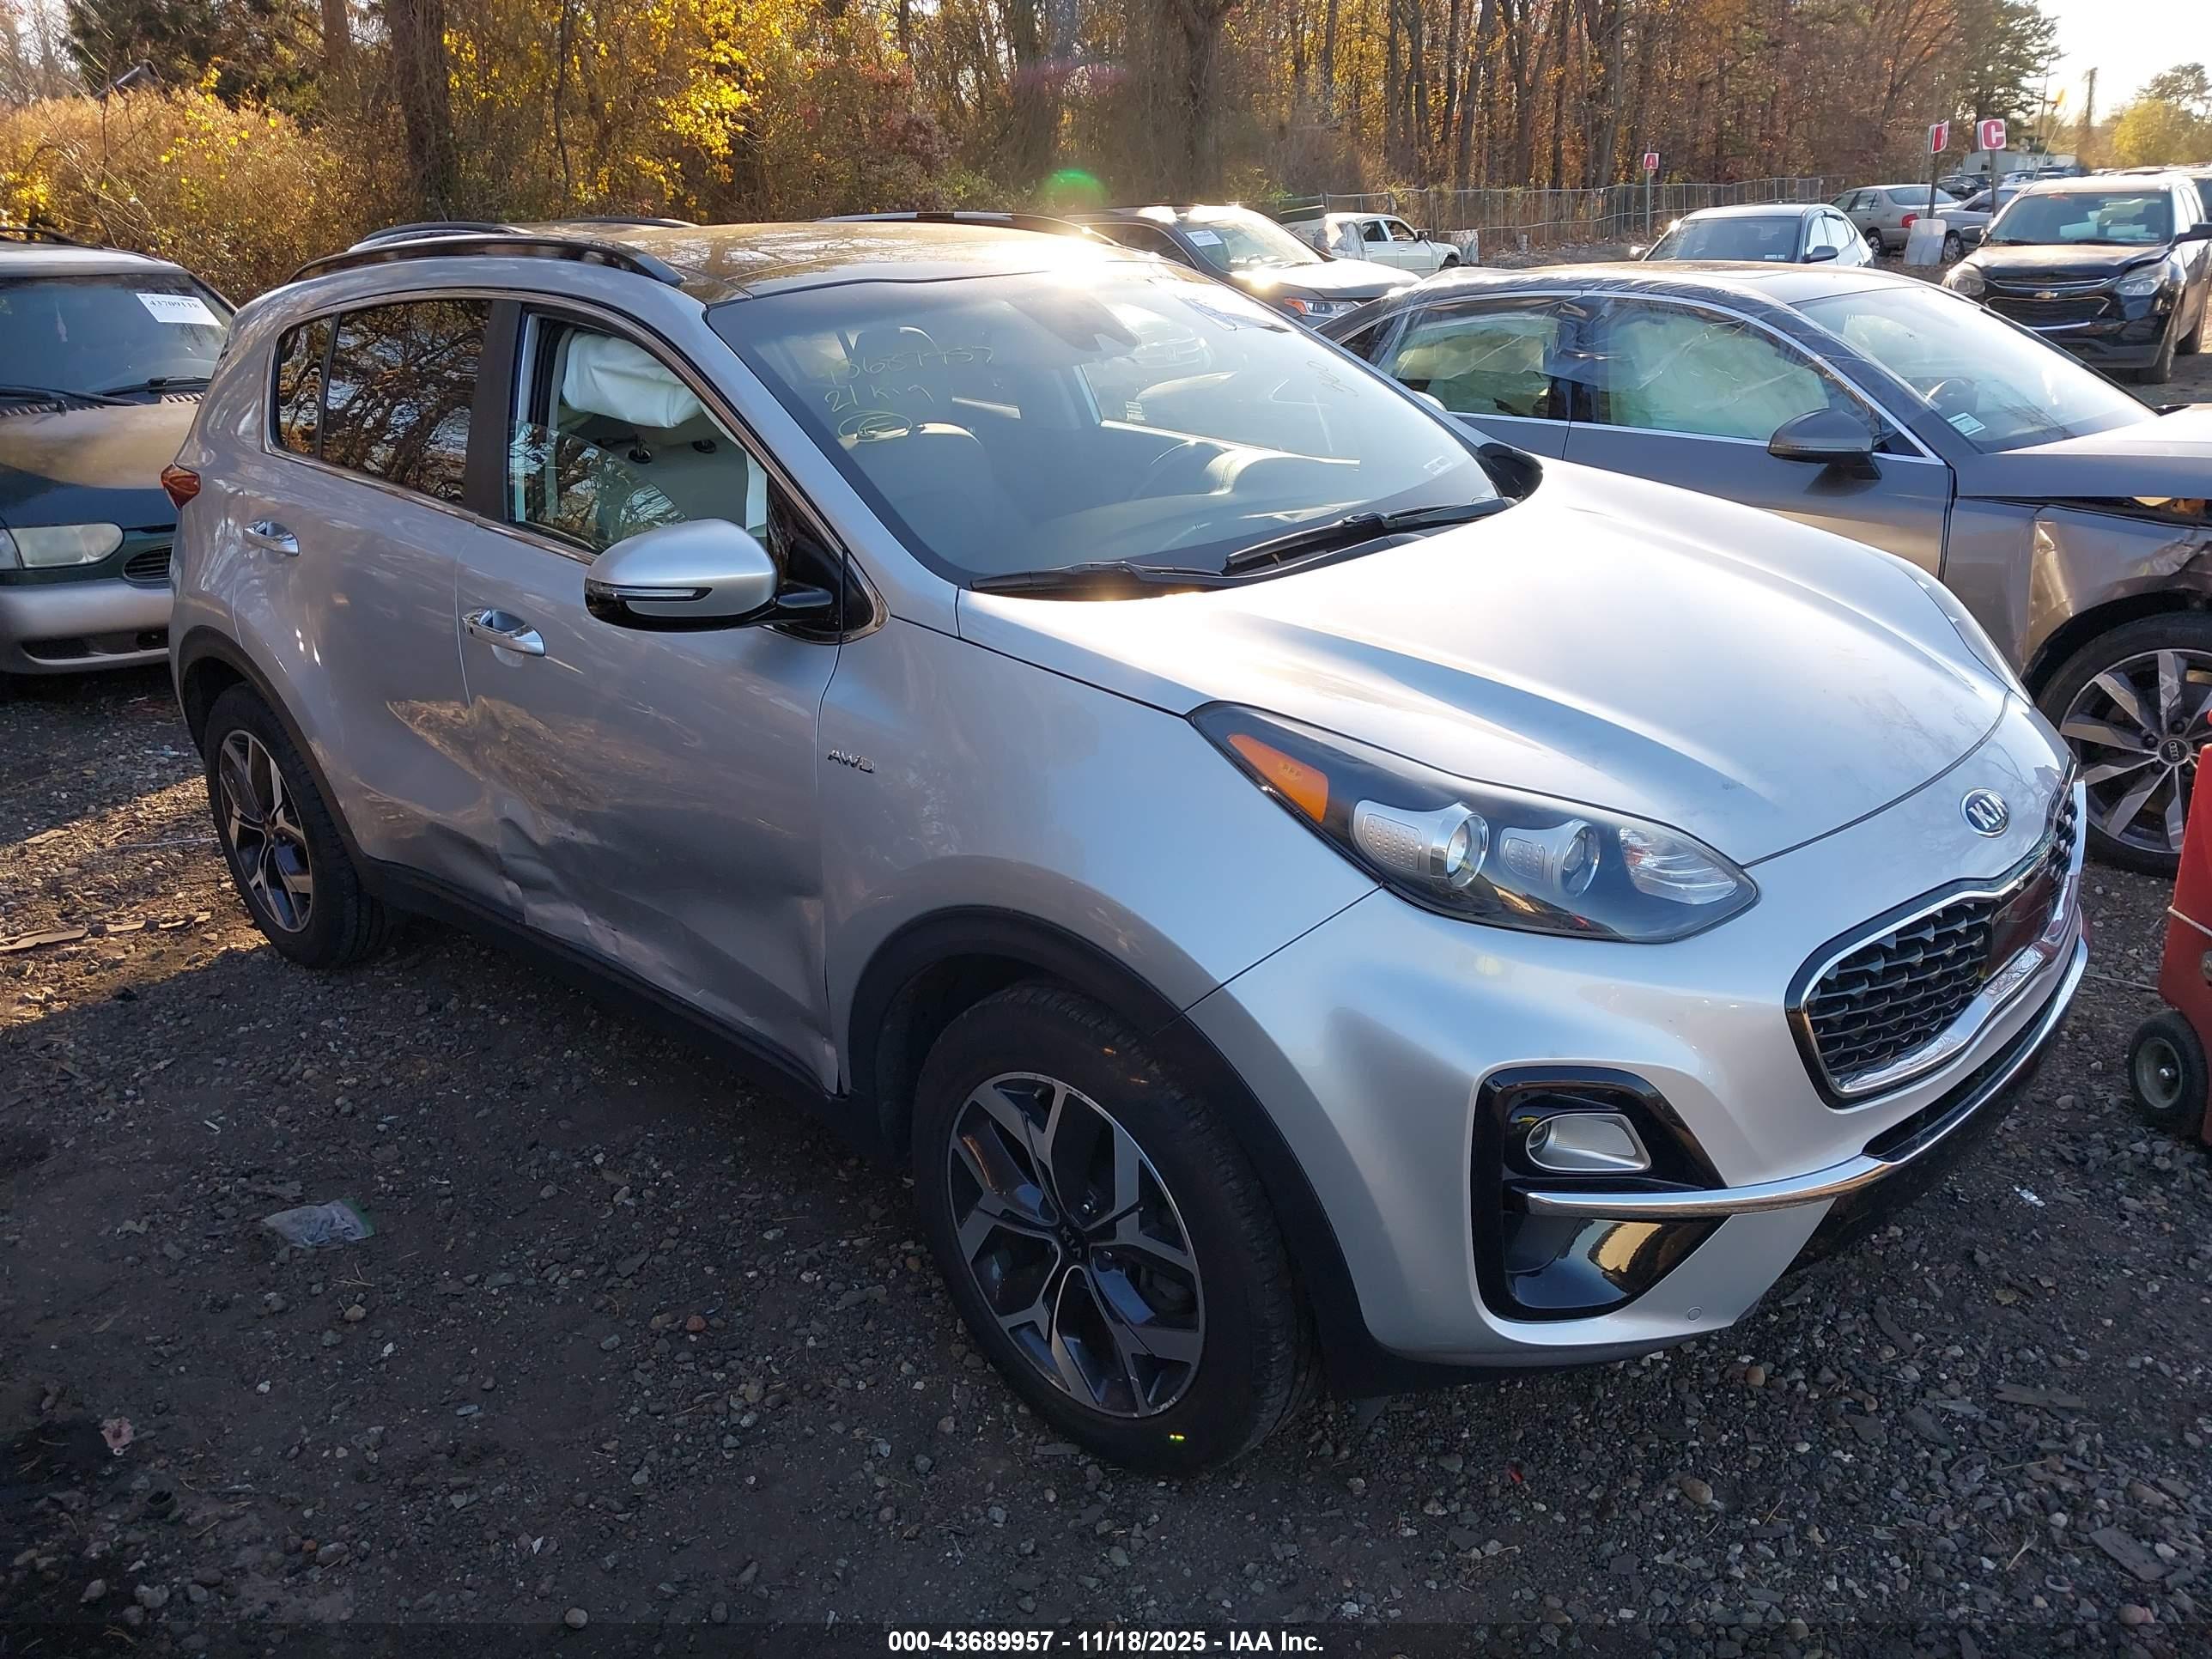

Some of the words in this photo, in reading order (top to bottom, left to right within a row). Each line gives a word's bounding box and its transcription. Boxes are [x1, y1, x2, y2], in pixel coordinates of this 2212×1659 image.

[1983, 120, 2005, 148] C
[827, 750, 875, 774] AWD
[1967, 793, 2008, 830] KIA
